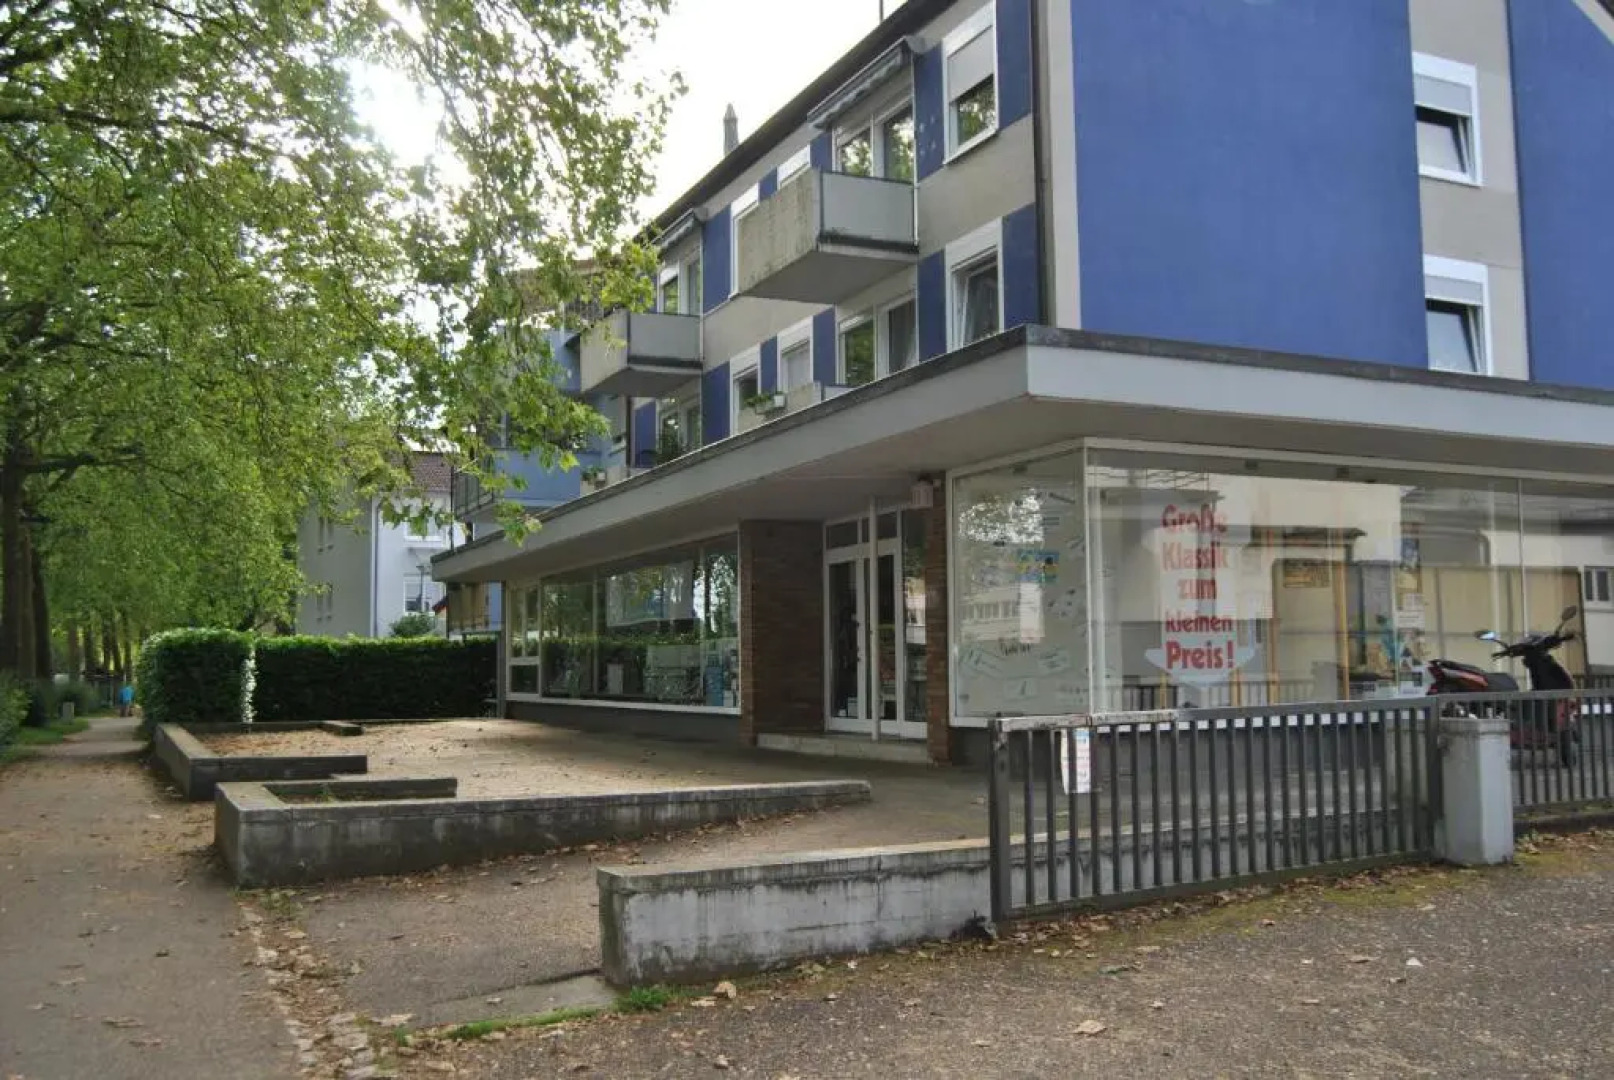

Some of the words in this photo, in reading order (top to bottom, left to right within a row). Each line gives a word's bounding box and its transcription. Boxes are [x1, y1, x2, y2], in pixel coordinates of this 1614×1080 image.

[1163, 541, 1229, 571] Klassik
[1178, 578, 1217, 600] zum
[1165, 611, 1232, 633] kleinen
[1165, 640, 1234, 670] Preis!
